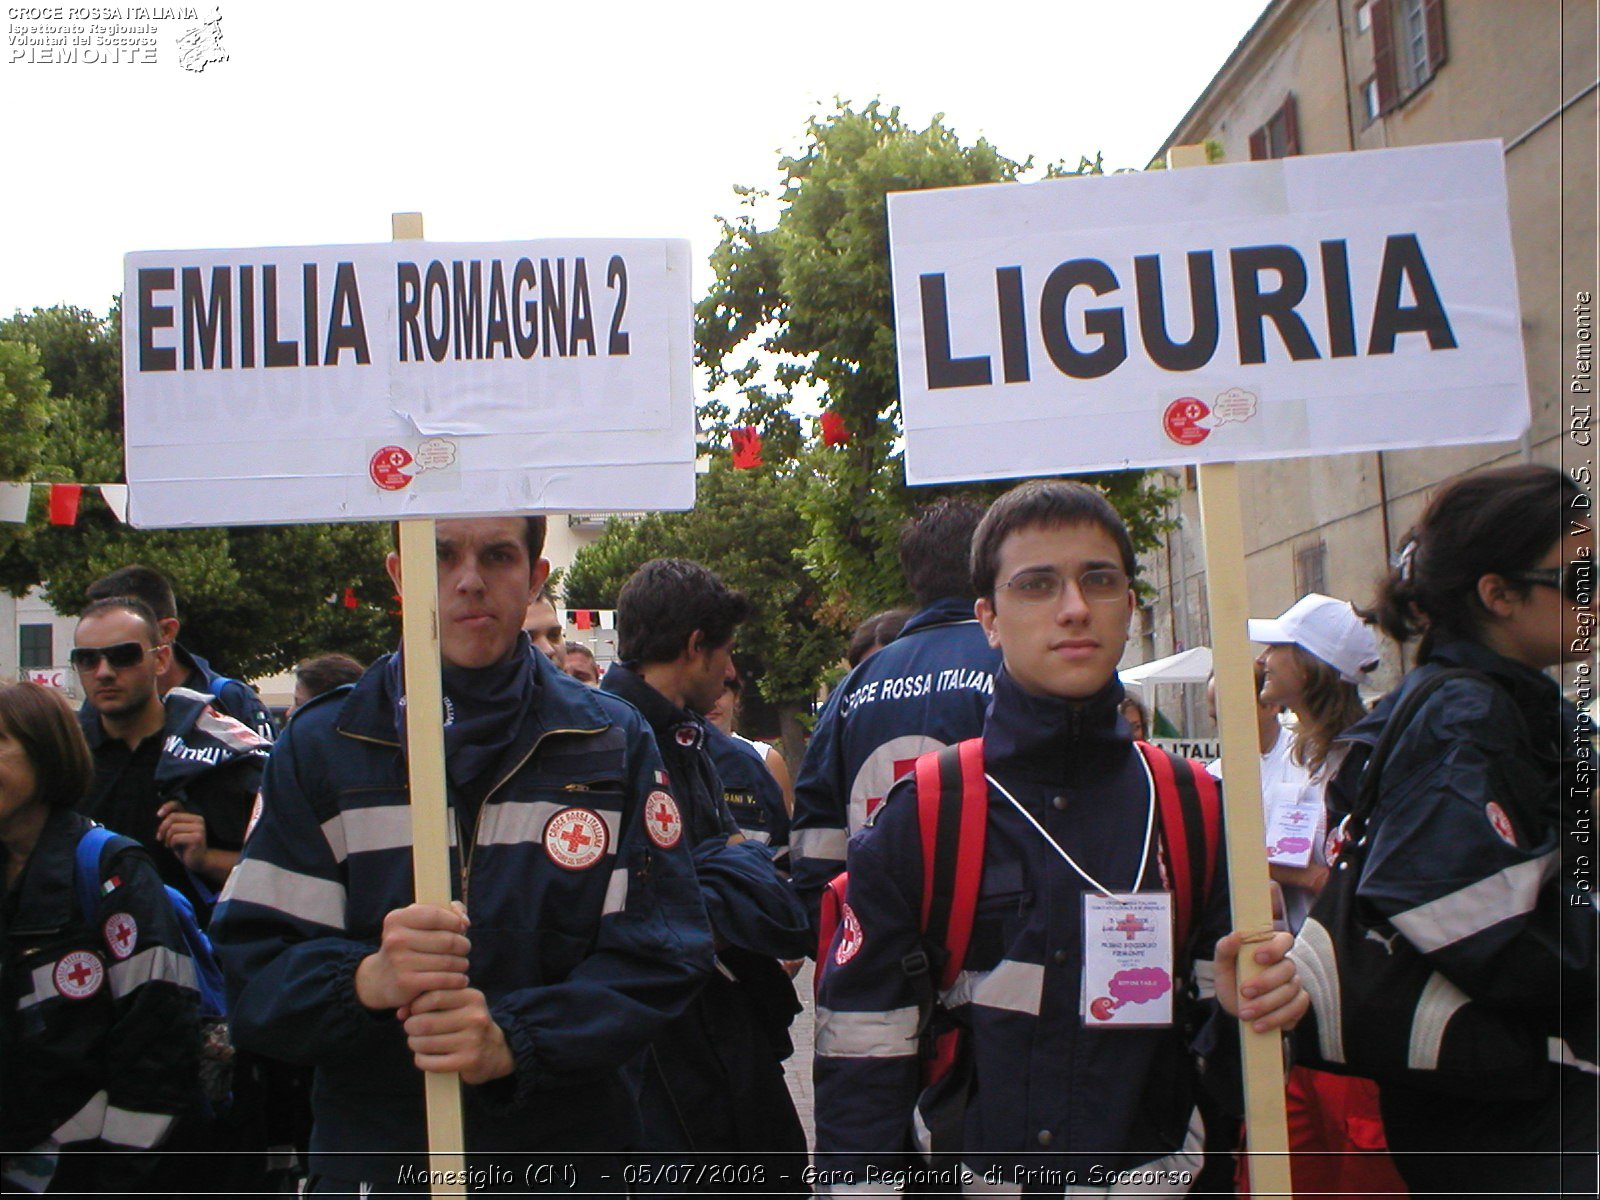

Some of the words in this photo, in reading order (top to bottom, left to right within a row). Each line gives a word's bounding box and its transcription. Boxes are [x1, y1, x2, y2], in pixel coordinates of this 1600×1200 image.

[138, 261, 371, 372] EMILIA
[397, 257, 597, 362] ROMAGNA
[607, 255, 630, 356] 2
[920, 233, 1459, 389] LIGURIA
[880, 673, 932, 700] ROSSA
